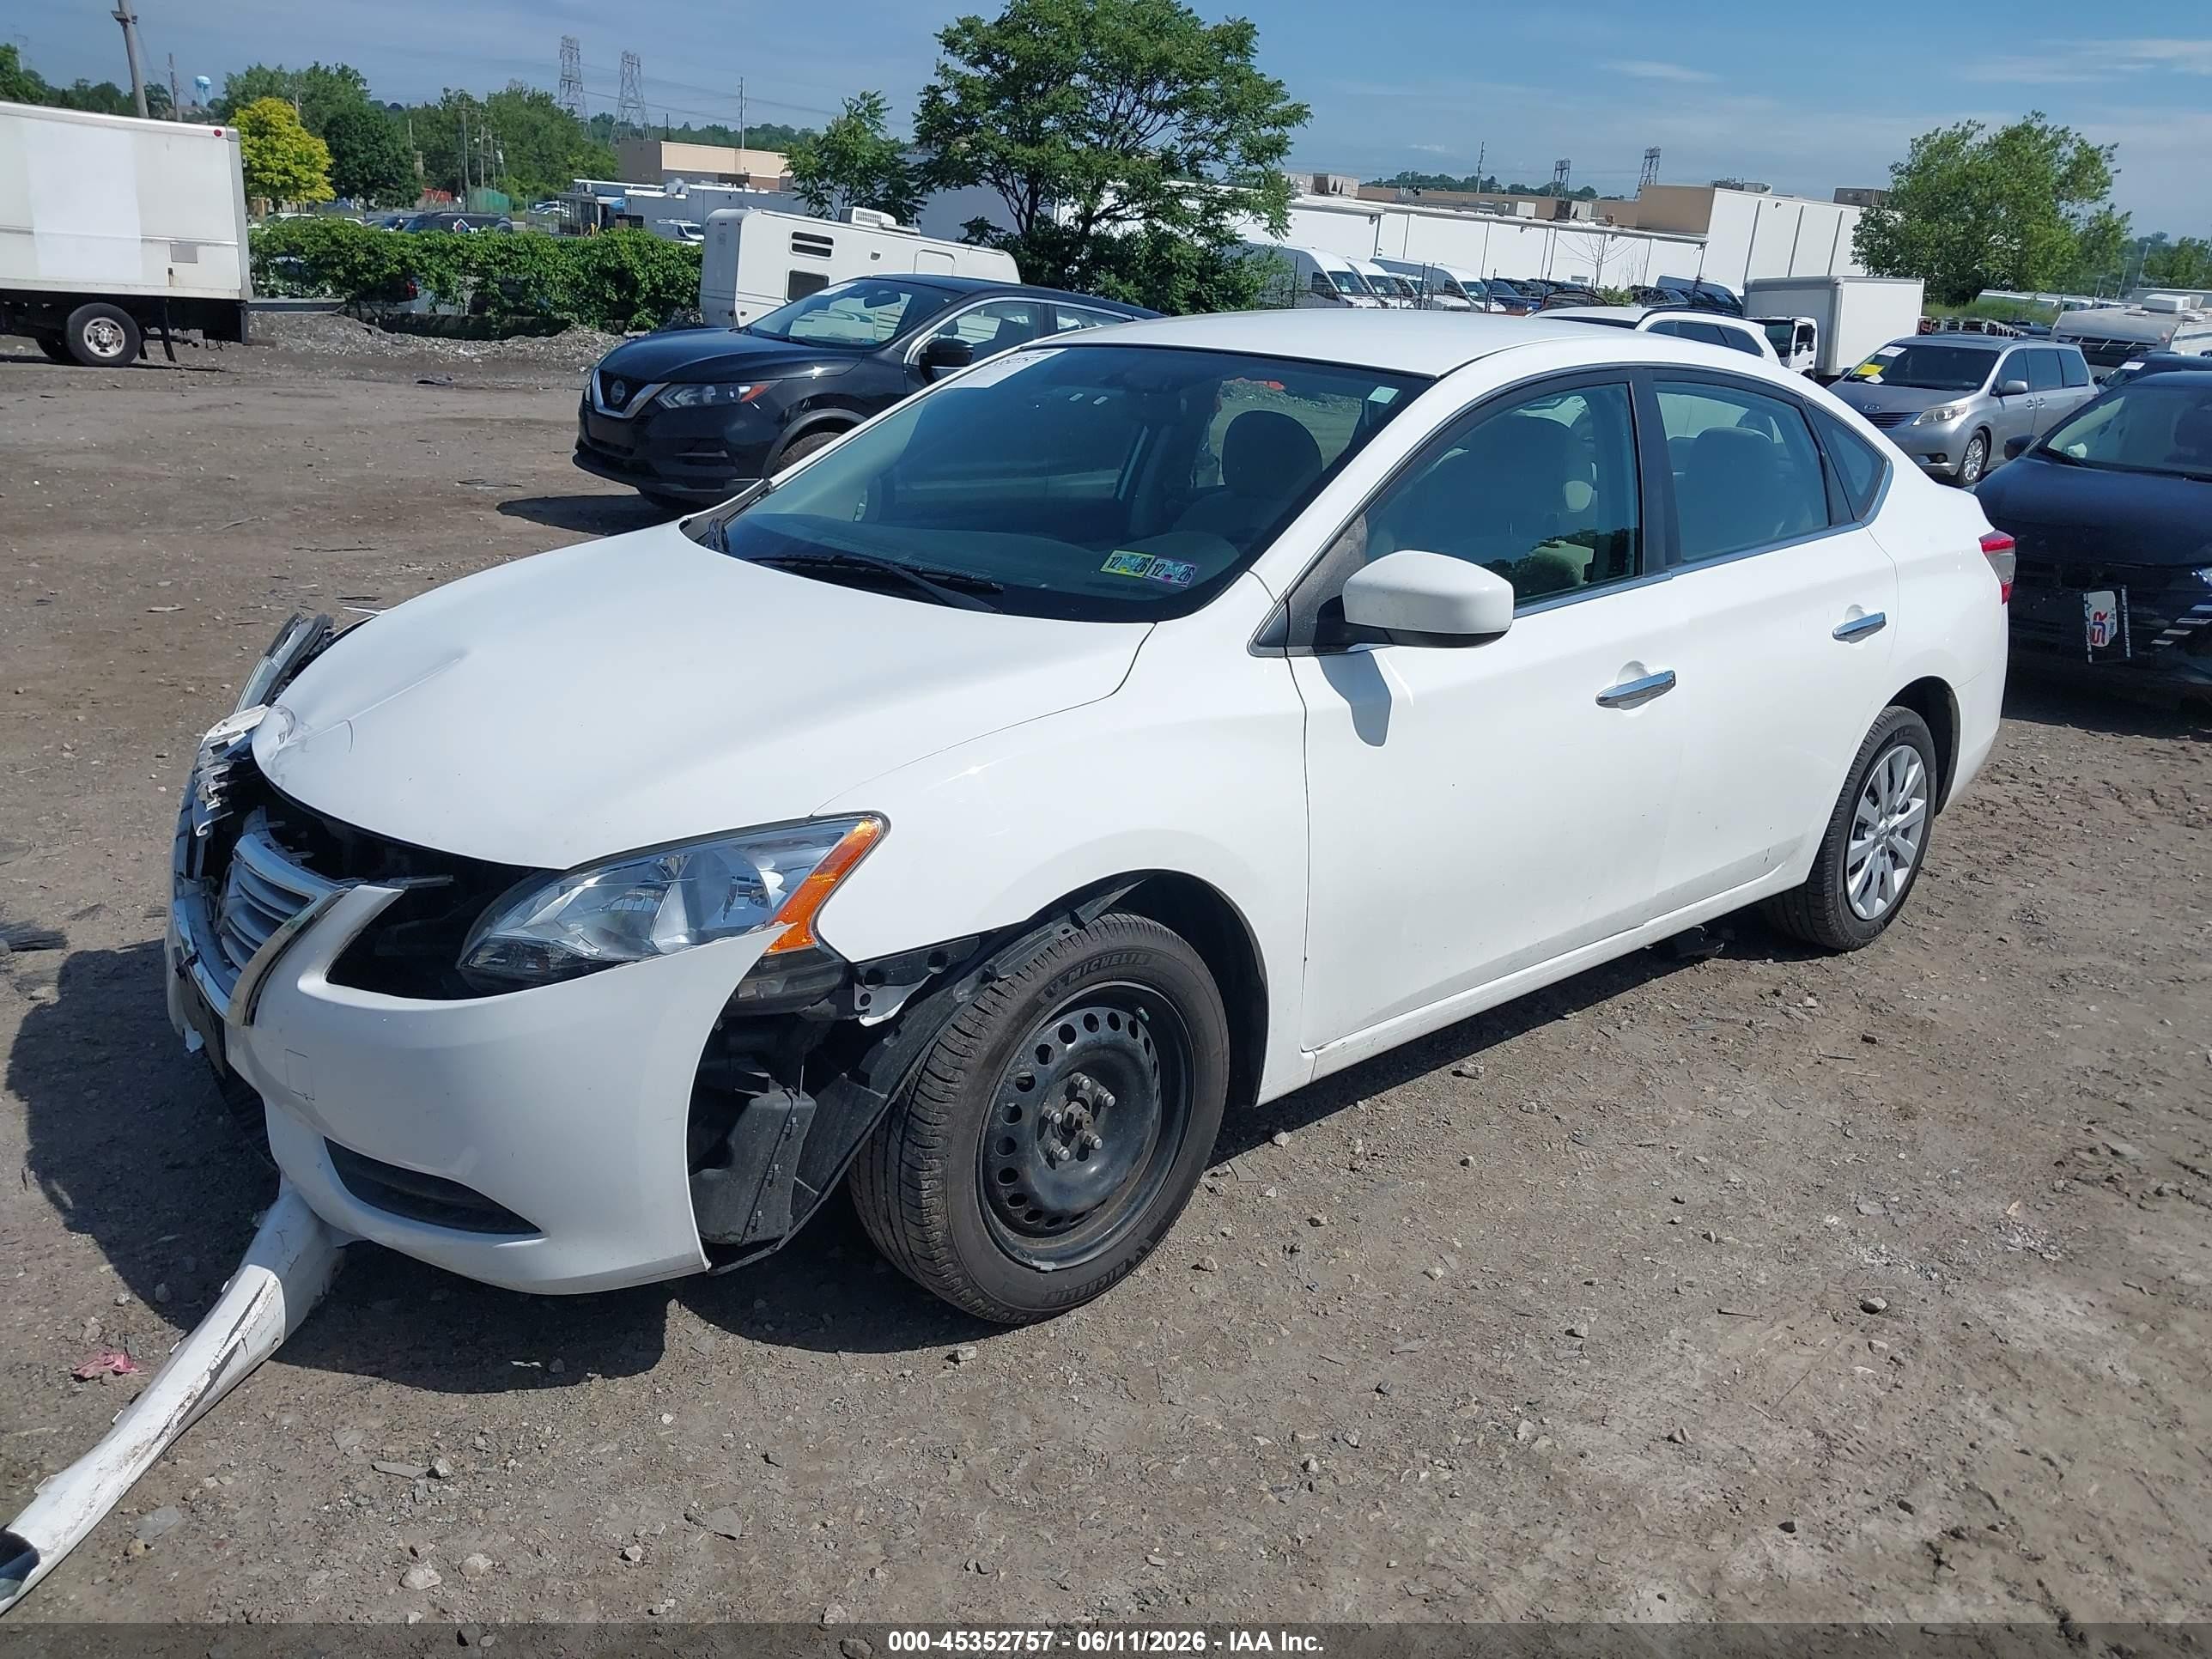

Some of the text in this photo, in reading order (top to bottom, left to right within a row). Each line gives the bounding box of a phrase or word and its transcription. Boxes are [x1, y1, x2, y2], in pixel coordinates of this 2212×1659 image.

[1109, 556, 1151, 574] 12 26
[1151, 562, 1195, 582] 12 26
[1068, 953, 1149, 983] MICHELIN
[1042, 1259, 1128, 1303] MICHELIN
